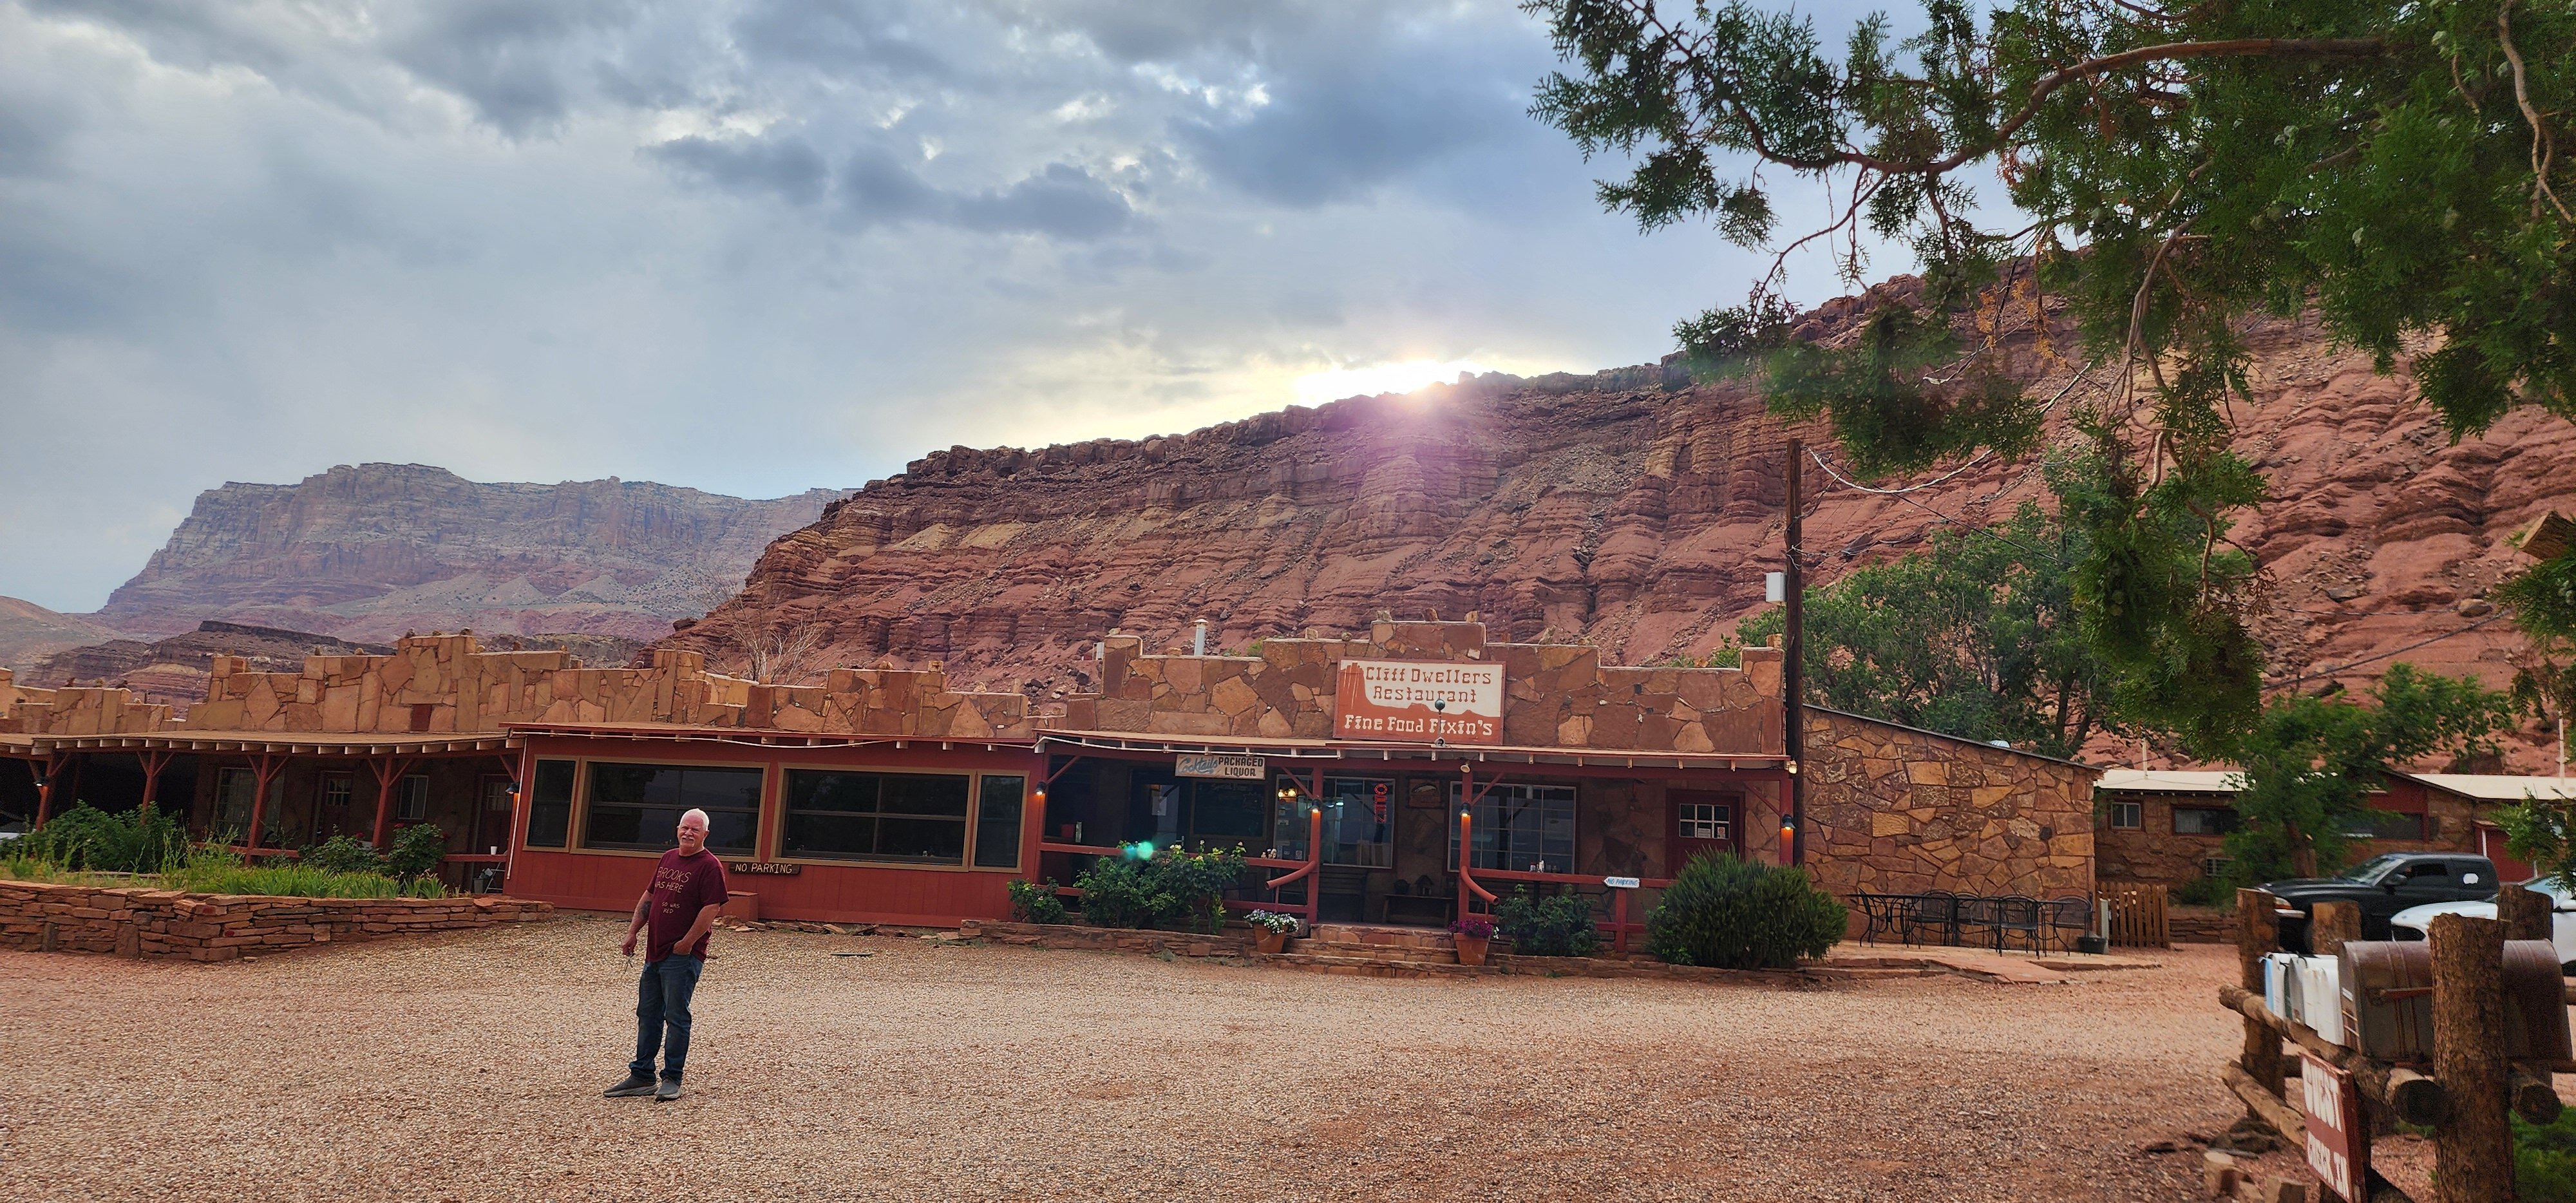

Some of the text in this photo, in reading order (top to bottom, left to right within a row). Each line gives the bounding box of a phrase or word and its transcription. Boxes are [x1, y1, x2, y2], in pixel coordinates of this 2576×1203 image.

[1365, 666, 1492, 685] Cliff Dwellers
[1373, 685, 1477, 703] Restaurant
[1344, 714, 1493, 736] Fine Food Fixin's
[1177, 756, 1218, 774] Cocktails
[1218, 757, 1264, 767] PACKAGED
[1224, 767, 1256, 777] LIQUOR
[657, 866, 692, 883] BROOKS
[735, 863, 793, 874] NO PARKING
[666, 882, 684, 893] HERE
[2302, 1056, 2342, 1132] GUEST
[2333, 1151, 2350, 1199] IN
